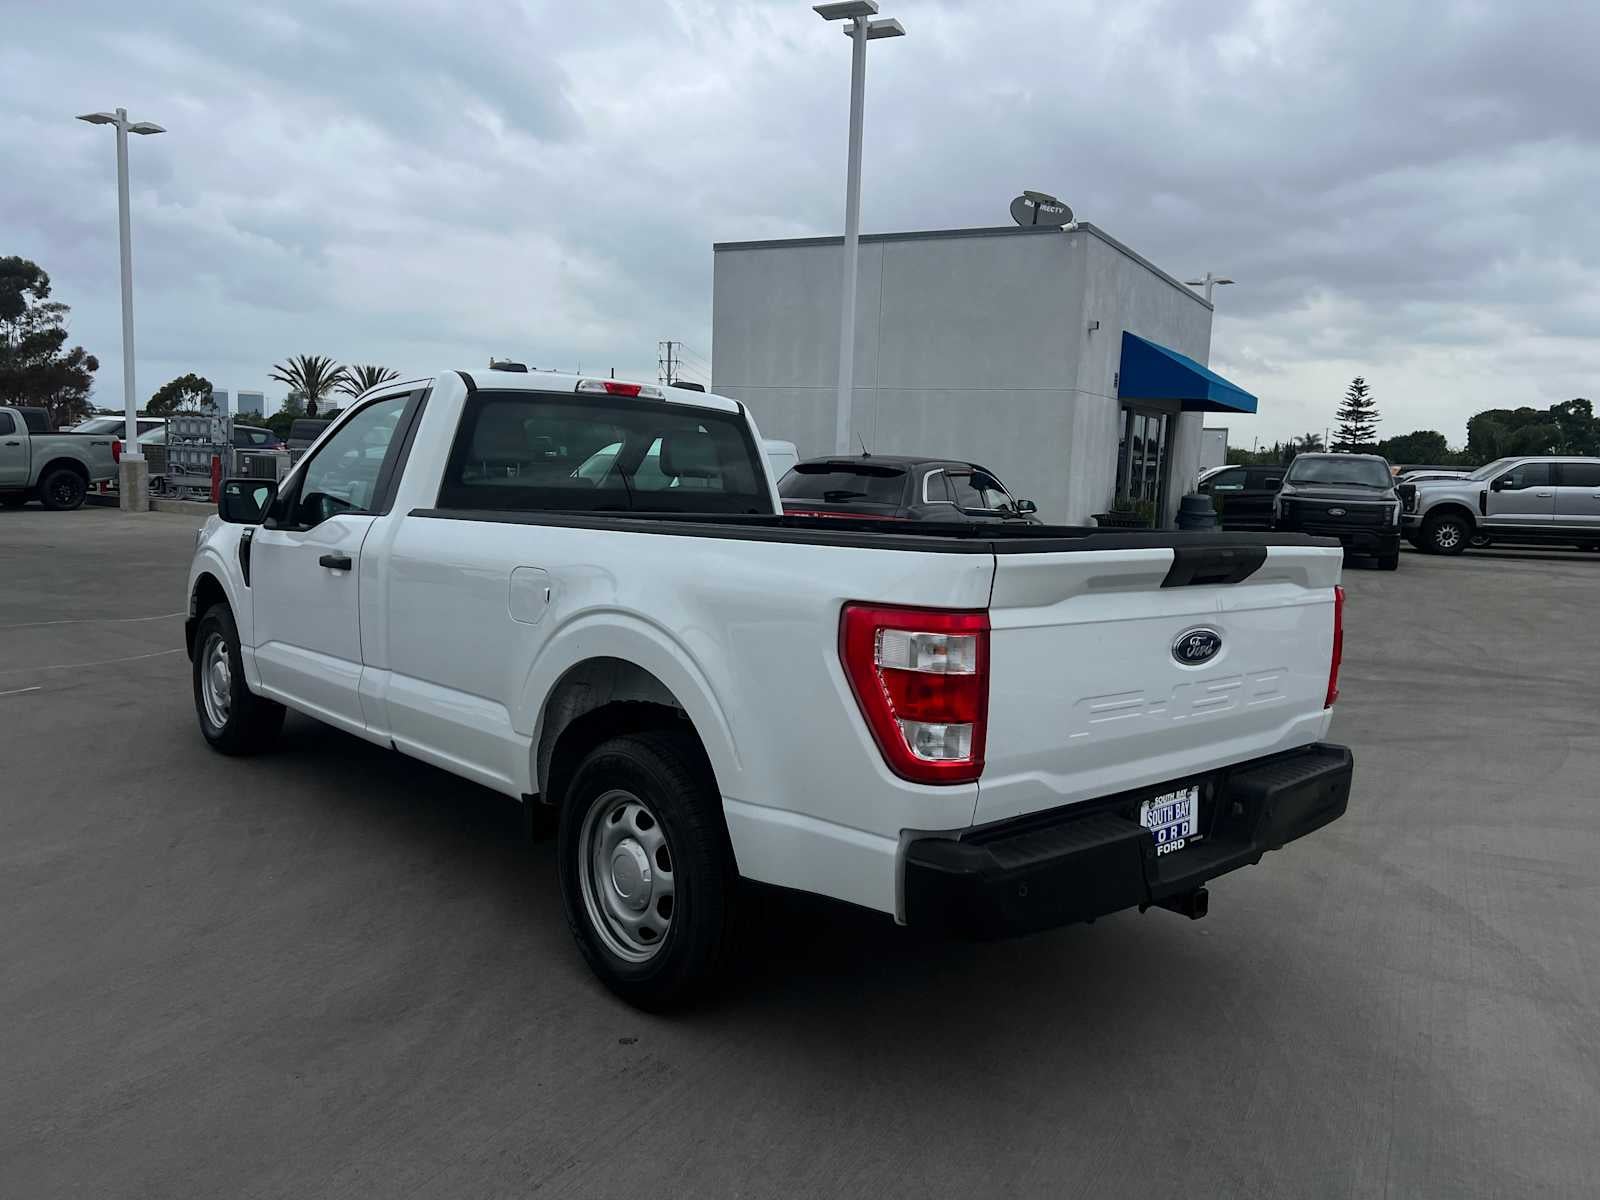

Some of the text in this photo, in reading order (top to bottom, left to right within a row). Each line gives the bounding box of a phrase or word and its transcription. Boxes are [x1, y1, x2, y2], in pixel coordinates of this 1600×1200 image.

[1186, 636, 1214, 658] Ford
[1154, 788, 1188, 805] SOUTH BAY
[1147, 801, 1190, 828] SOUTH BAY
[1158, 822, 1189, 843] ORD
[1157, 838, 1185, 857] FORD
